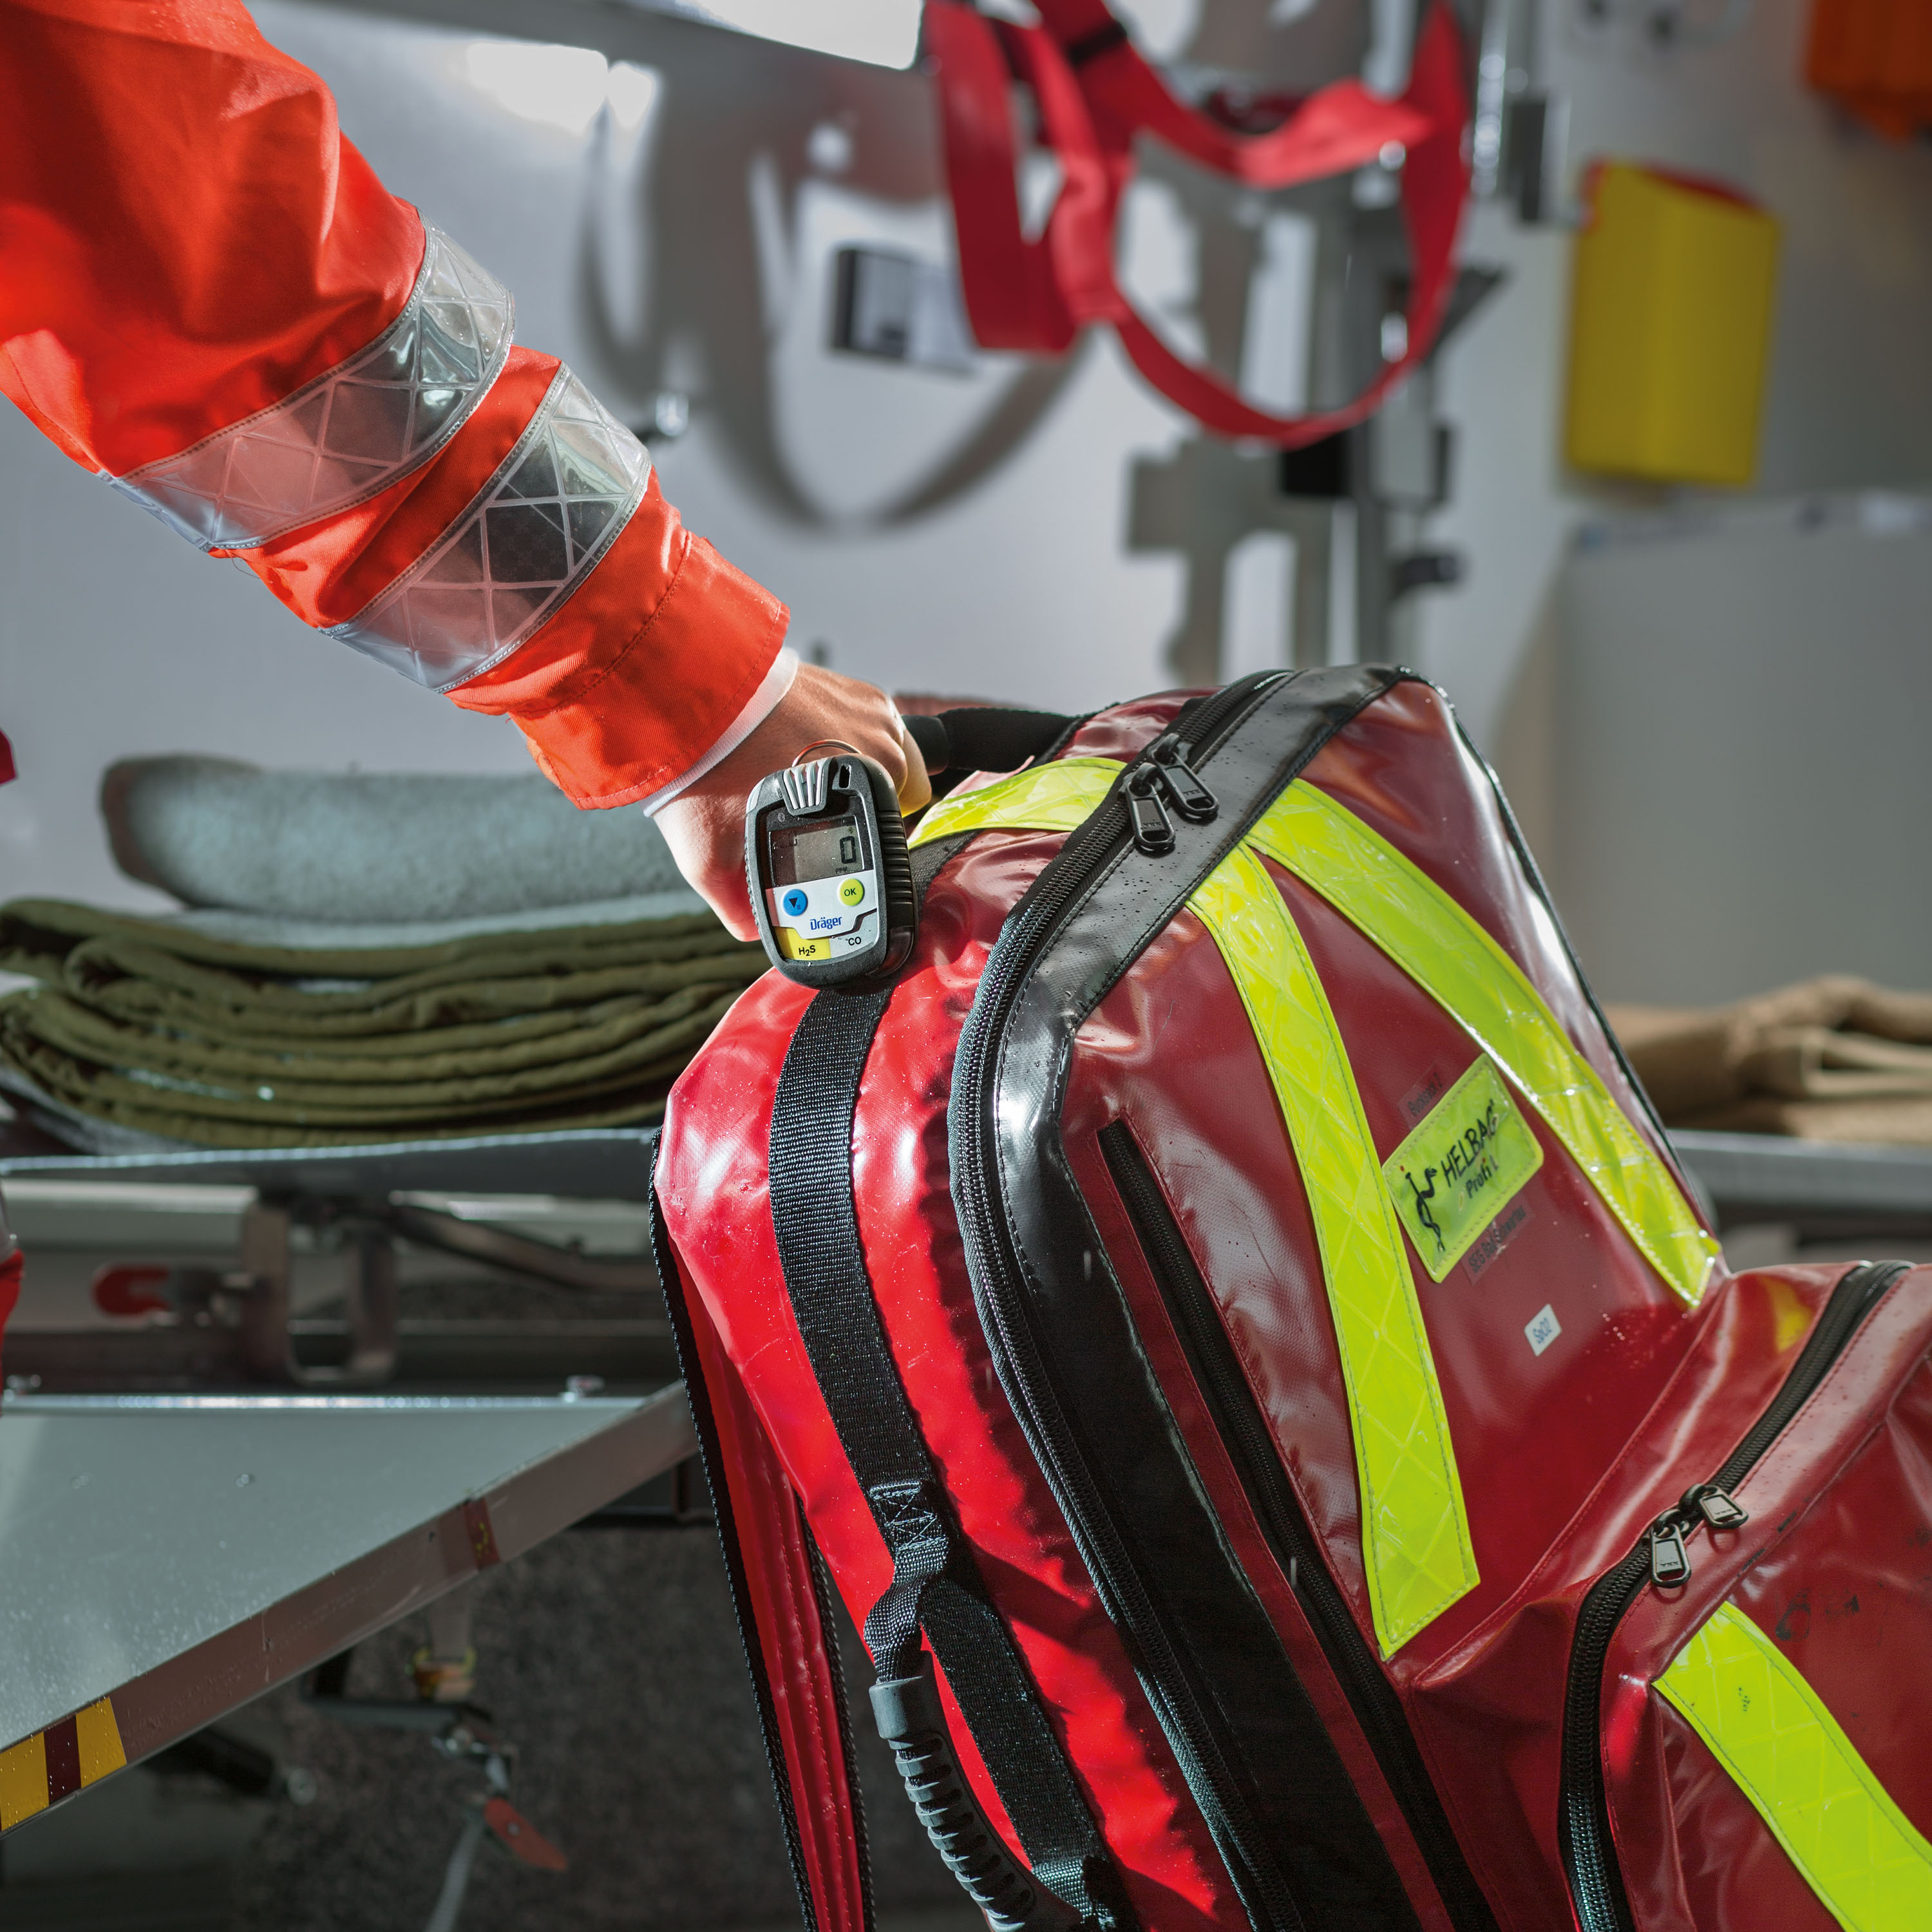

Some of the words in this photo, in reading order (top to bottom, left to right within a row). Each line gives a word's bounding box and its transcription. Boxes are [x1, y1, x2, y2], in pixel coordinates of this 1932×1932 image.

[839, 836, 857, 864] 0
[844, 887, 857, 896] OK
[810, 916, 842, 931] Dräger
[848, 936, 862, 946] CO
[799, 945, 816, 956] H2S
